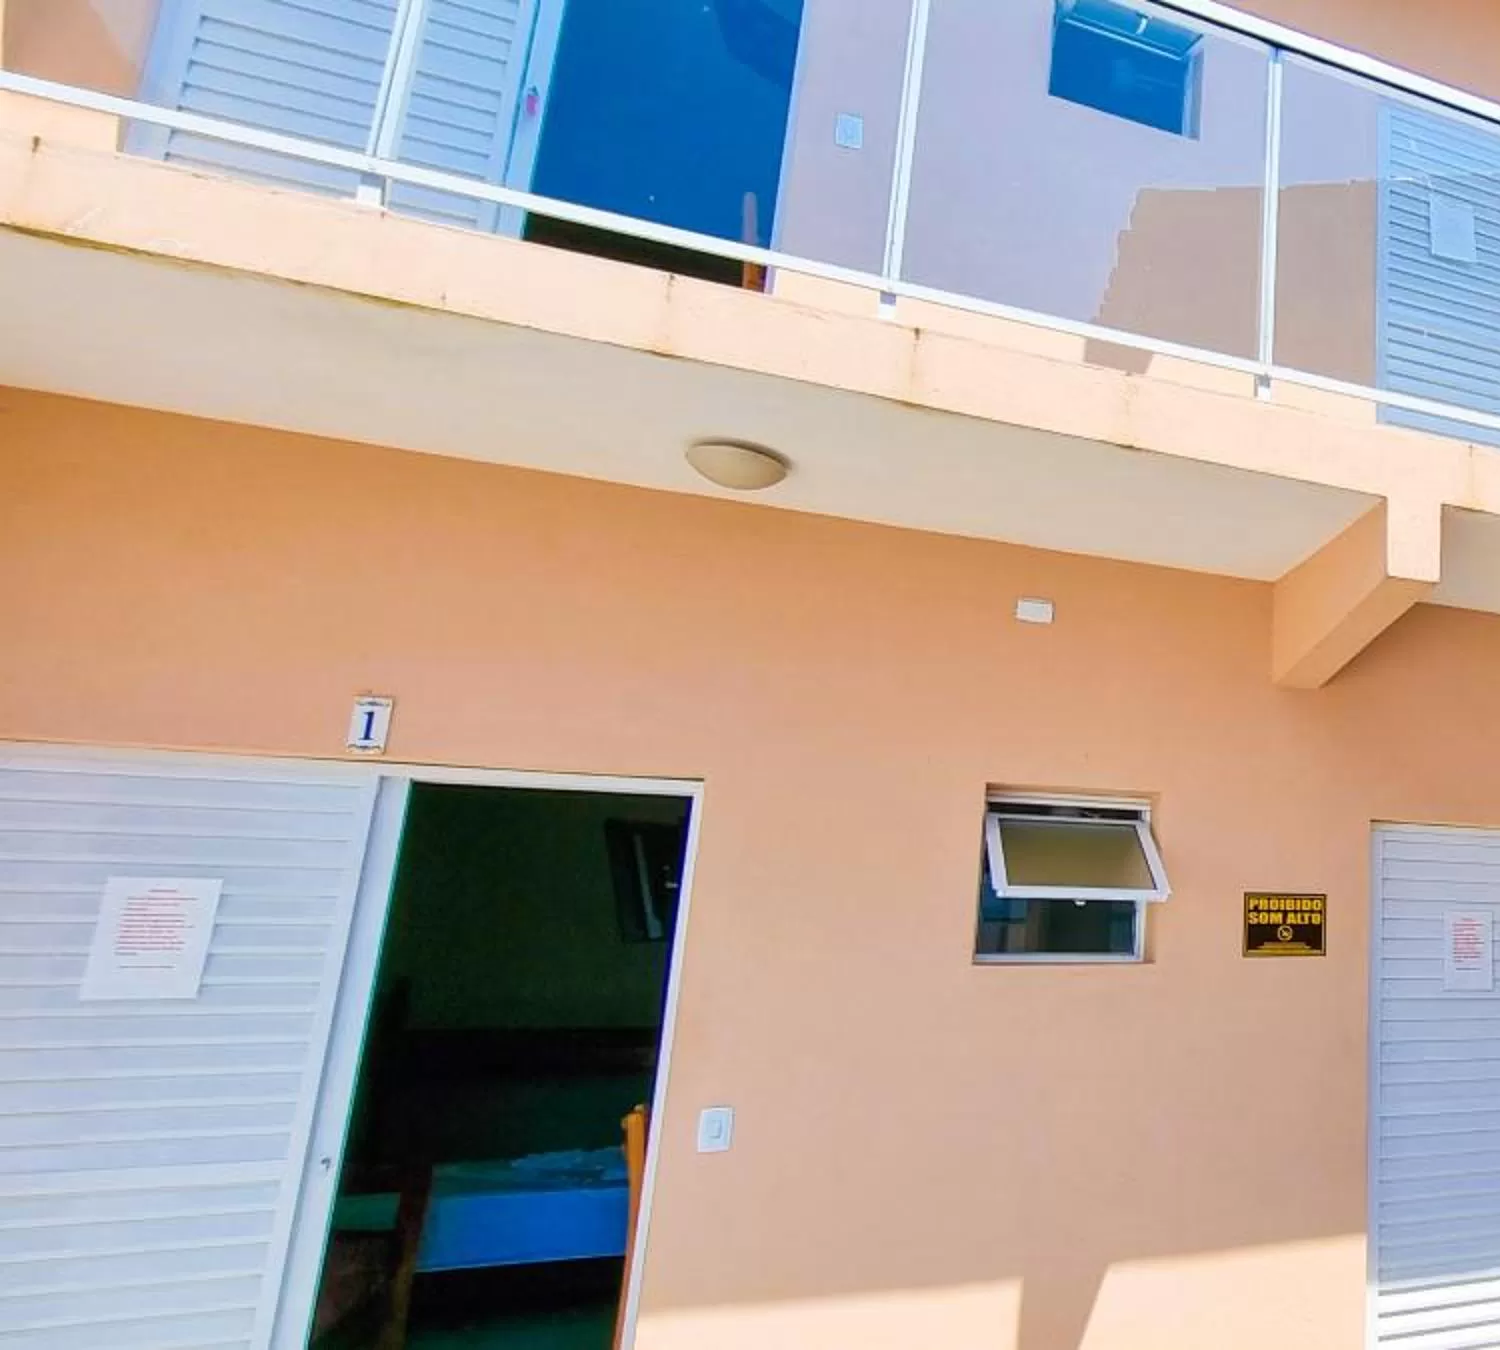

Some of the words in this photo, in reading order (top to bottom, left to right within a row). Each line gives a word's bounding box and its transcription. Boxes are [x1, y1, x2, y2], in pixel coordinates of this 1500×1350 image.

[361, 711, 375, 741] 1
[1248, 896, 1322, 911] PROIBIDO
[1247, 911, 1283, 925] SOM
[1286, 911, 1322, 925] ALTO
